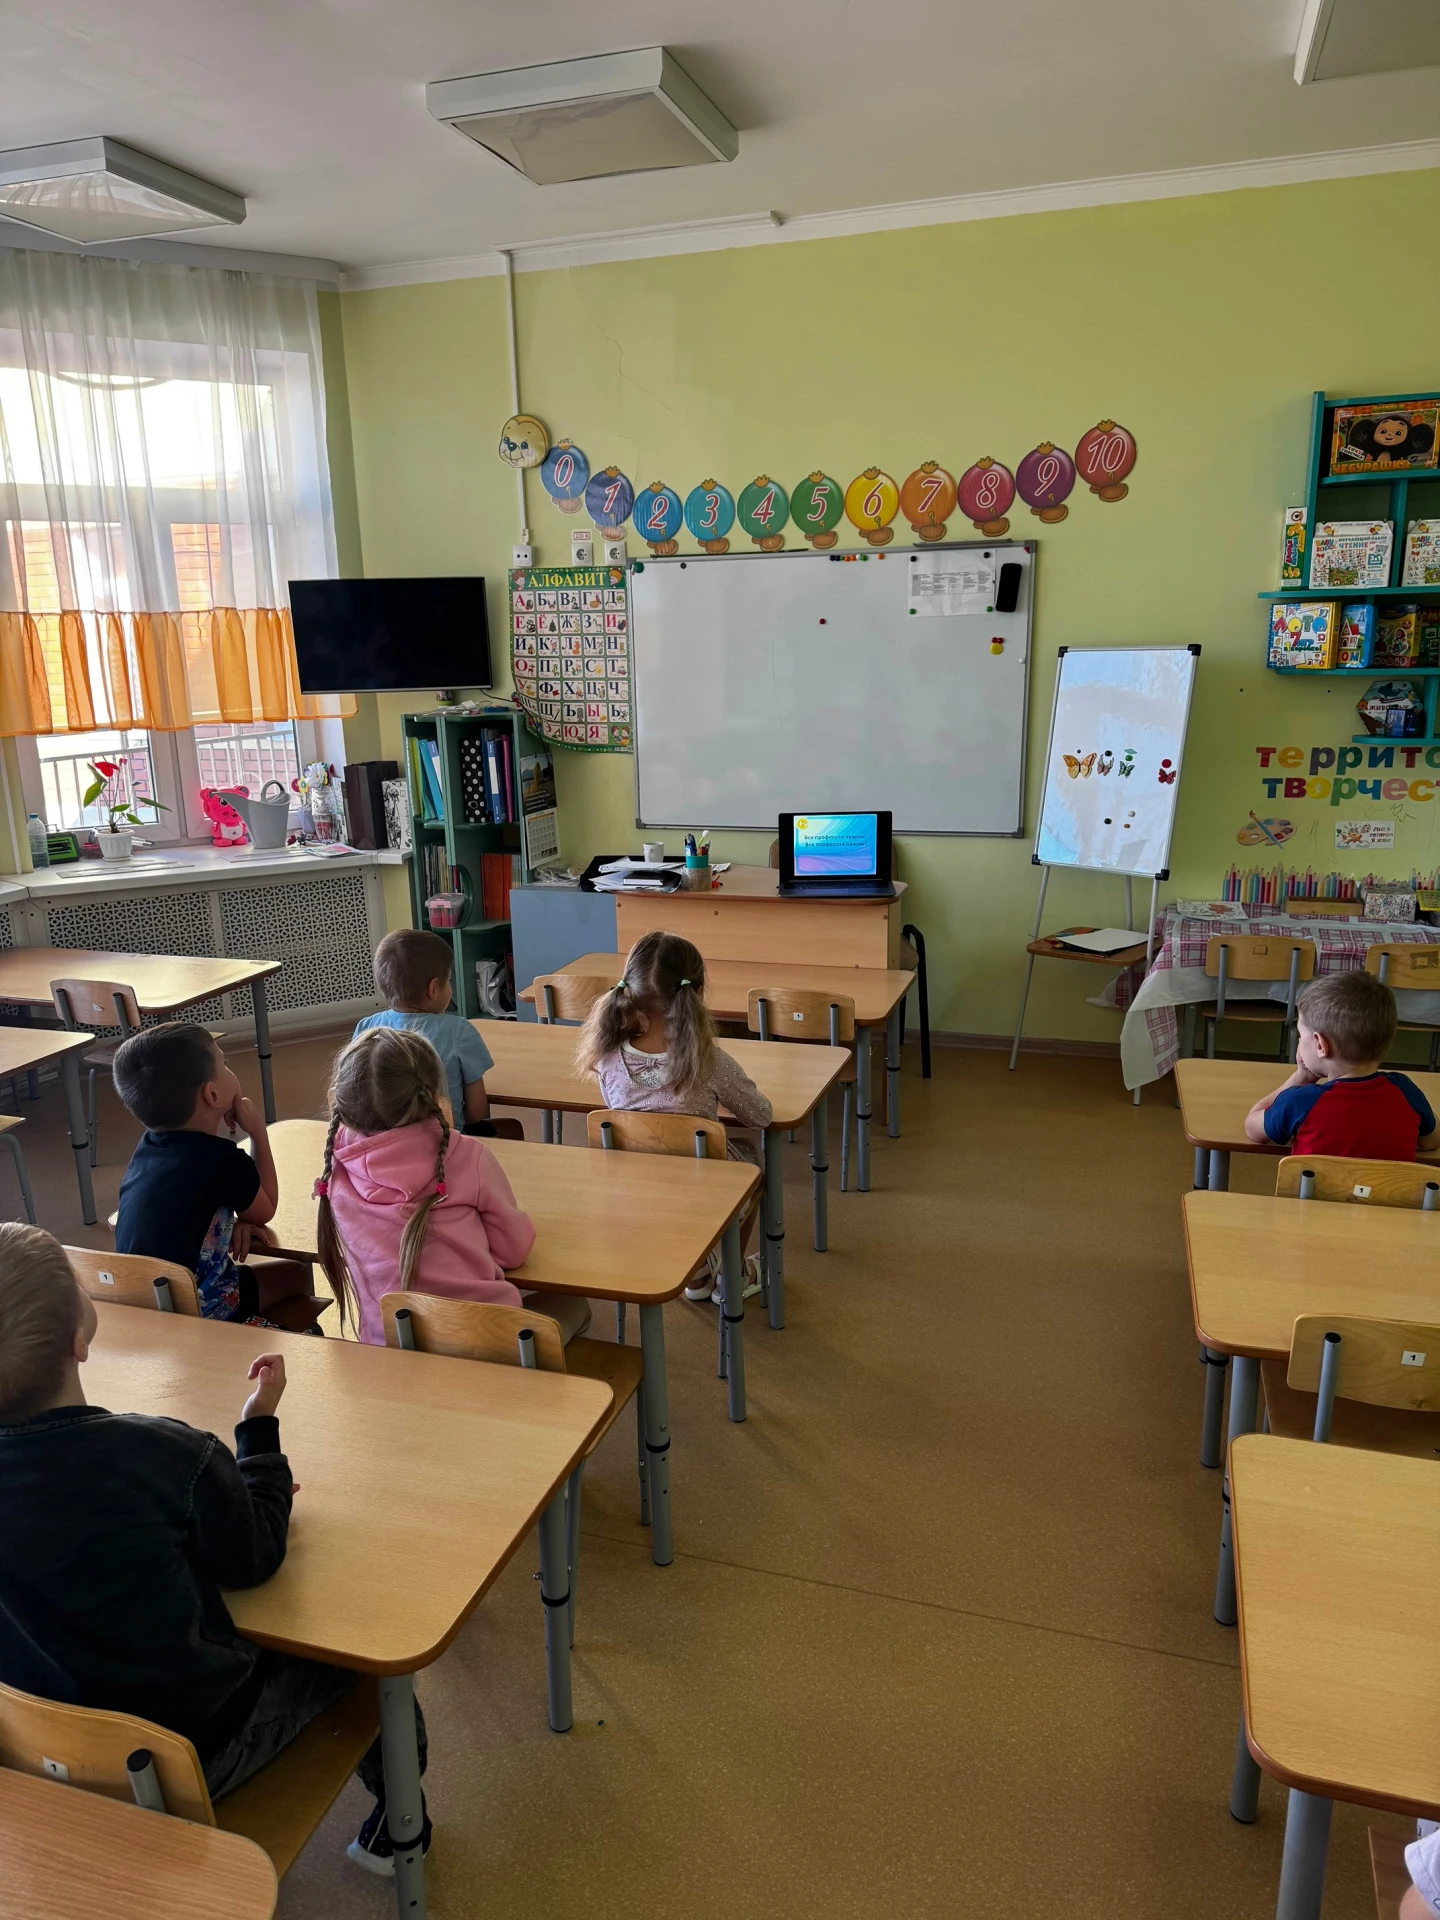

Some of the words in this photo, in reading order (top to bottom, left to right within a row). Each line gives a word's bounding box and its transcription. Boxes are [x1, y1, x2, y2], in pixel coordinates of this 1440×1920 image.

[554, 454, 574, 488] 0
[603, 482, 622, 512] 1
[647, 496, 670, 530] 2
[700, 494, 720, 528] 3
[752, 488, 775, 524] 4
[807, 486, 830, 521] 5
[863, 482, 884, 518] 6
[918, 478, 944, 512] 7
[976, 472, 1000, 509] 8
[1034, 457, 1060, 496] 9
[1087, 434, 1128, 474] 10
[528, 572, 606, 588] АЛФАВИТ
[515, 594, 525, 606] А
[538, 593, 547, 606] Б
[560, 592, 570, 605] В
[582, 592, 592, 605] Г
[606, 591, 616, 605] Д
[515, 616, 525, 628] Е
[538, 614, 547, 628] Ё
[561, 615, 573, 628] Ж
[584, 614, 592, 628] З
[606, 614, 616, 627] И
[1273, 615, 1327, 634] ЛОТО
[515, 636, 526, 650] Й
[540, 638, 550, 650] К
[562, 638, 572, 650] Л
[584, 637, 596, 649] М
[607, 637, 618, 649] Н
[1290, 632, 1302, 646] 7
[515, 659, 527, 671] О
[540, 660, 550, 672] П
[564, 660, 573, 672] Р
[586, 659, 596, 672] С
[608, 659, 618, 672] Т
[517, 679, 527, 690] У
[540, 682, 553, 694] Ф
[564, 682, 575, 694] Х
[587, 682, 598, 697] Ц
[609, 682, 619, 694] Ч
[540, 704, 553, 718] Щ
[564, 704, 576, 716] Ъ
[588, 705, 599, 717] Ы
[611, 705, 620, 716] Ь
[564, 726, 578, 737] Ю
[589, 726, 599, 738] Я
[1262, 777, 1440, 806] творчес
